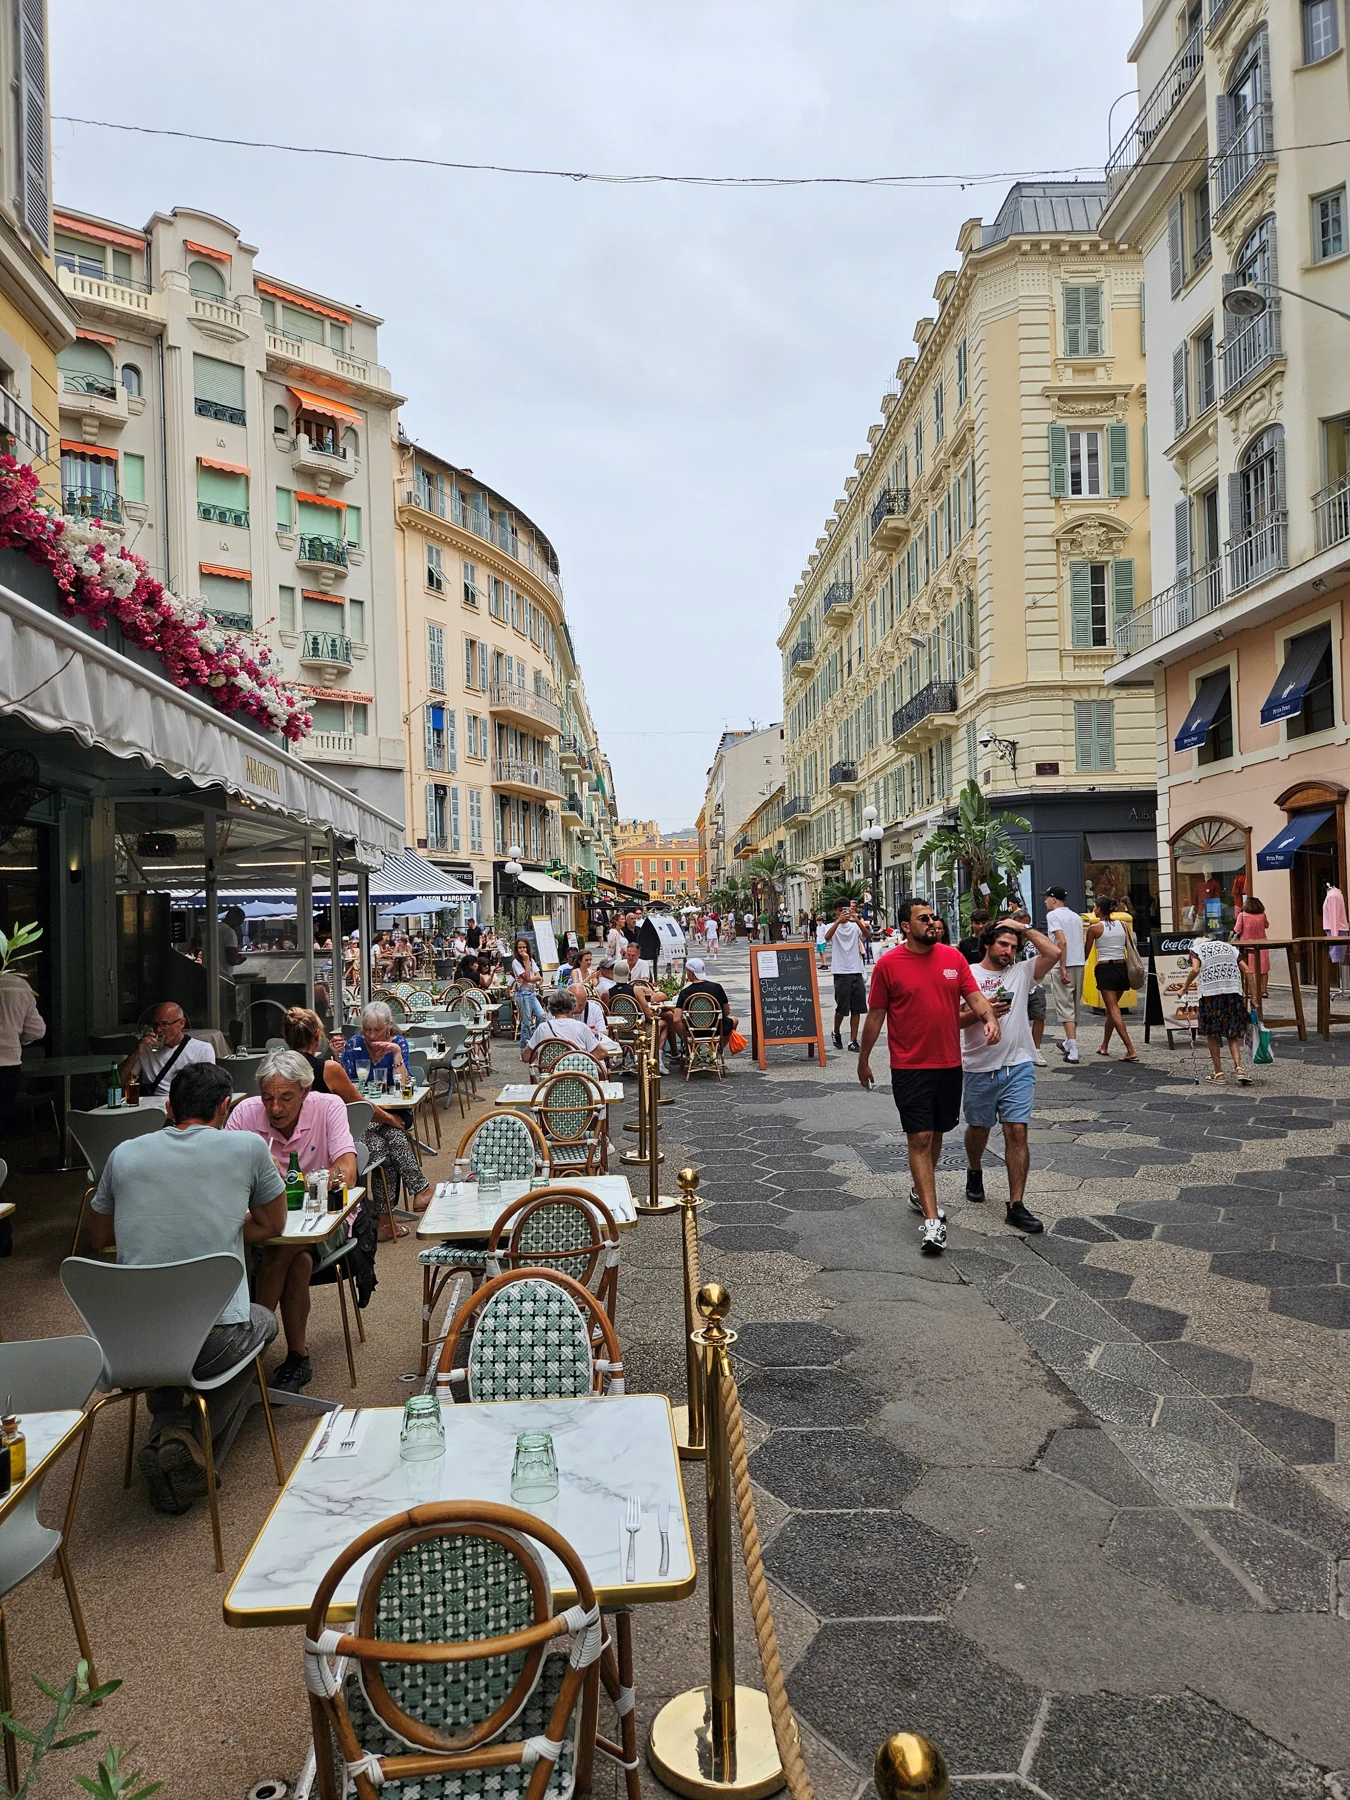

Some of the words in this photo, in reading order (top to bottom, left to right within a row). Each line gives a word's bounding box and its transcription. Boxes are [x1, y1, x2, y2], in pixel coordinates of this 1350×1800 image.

[313, 691, 348, 700] TRANSACTIONS
[353, 695, 373, 703] GESTION
[245, 755, 280, 795] MAGENTA
[1128, 807, 1155, 820] Auba
[1161, 938, 1194, 952] Coca-Col
[778, 953, 791, 962] Plat
